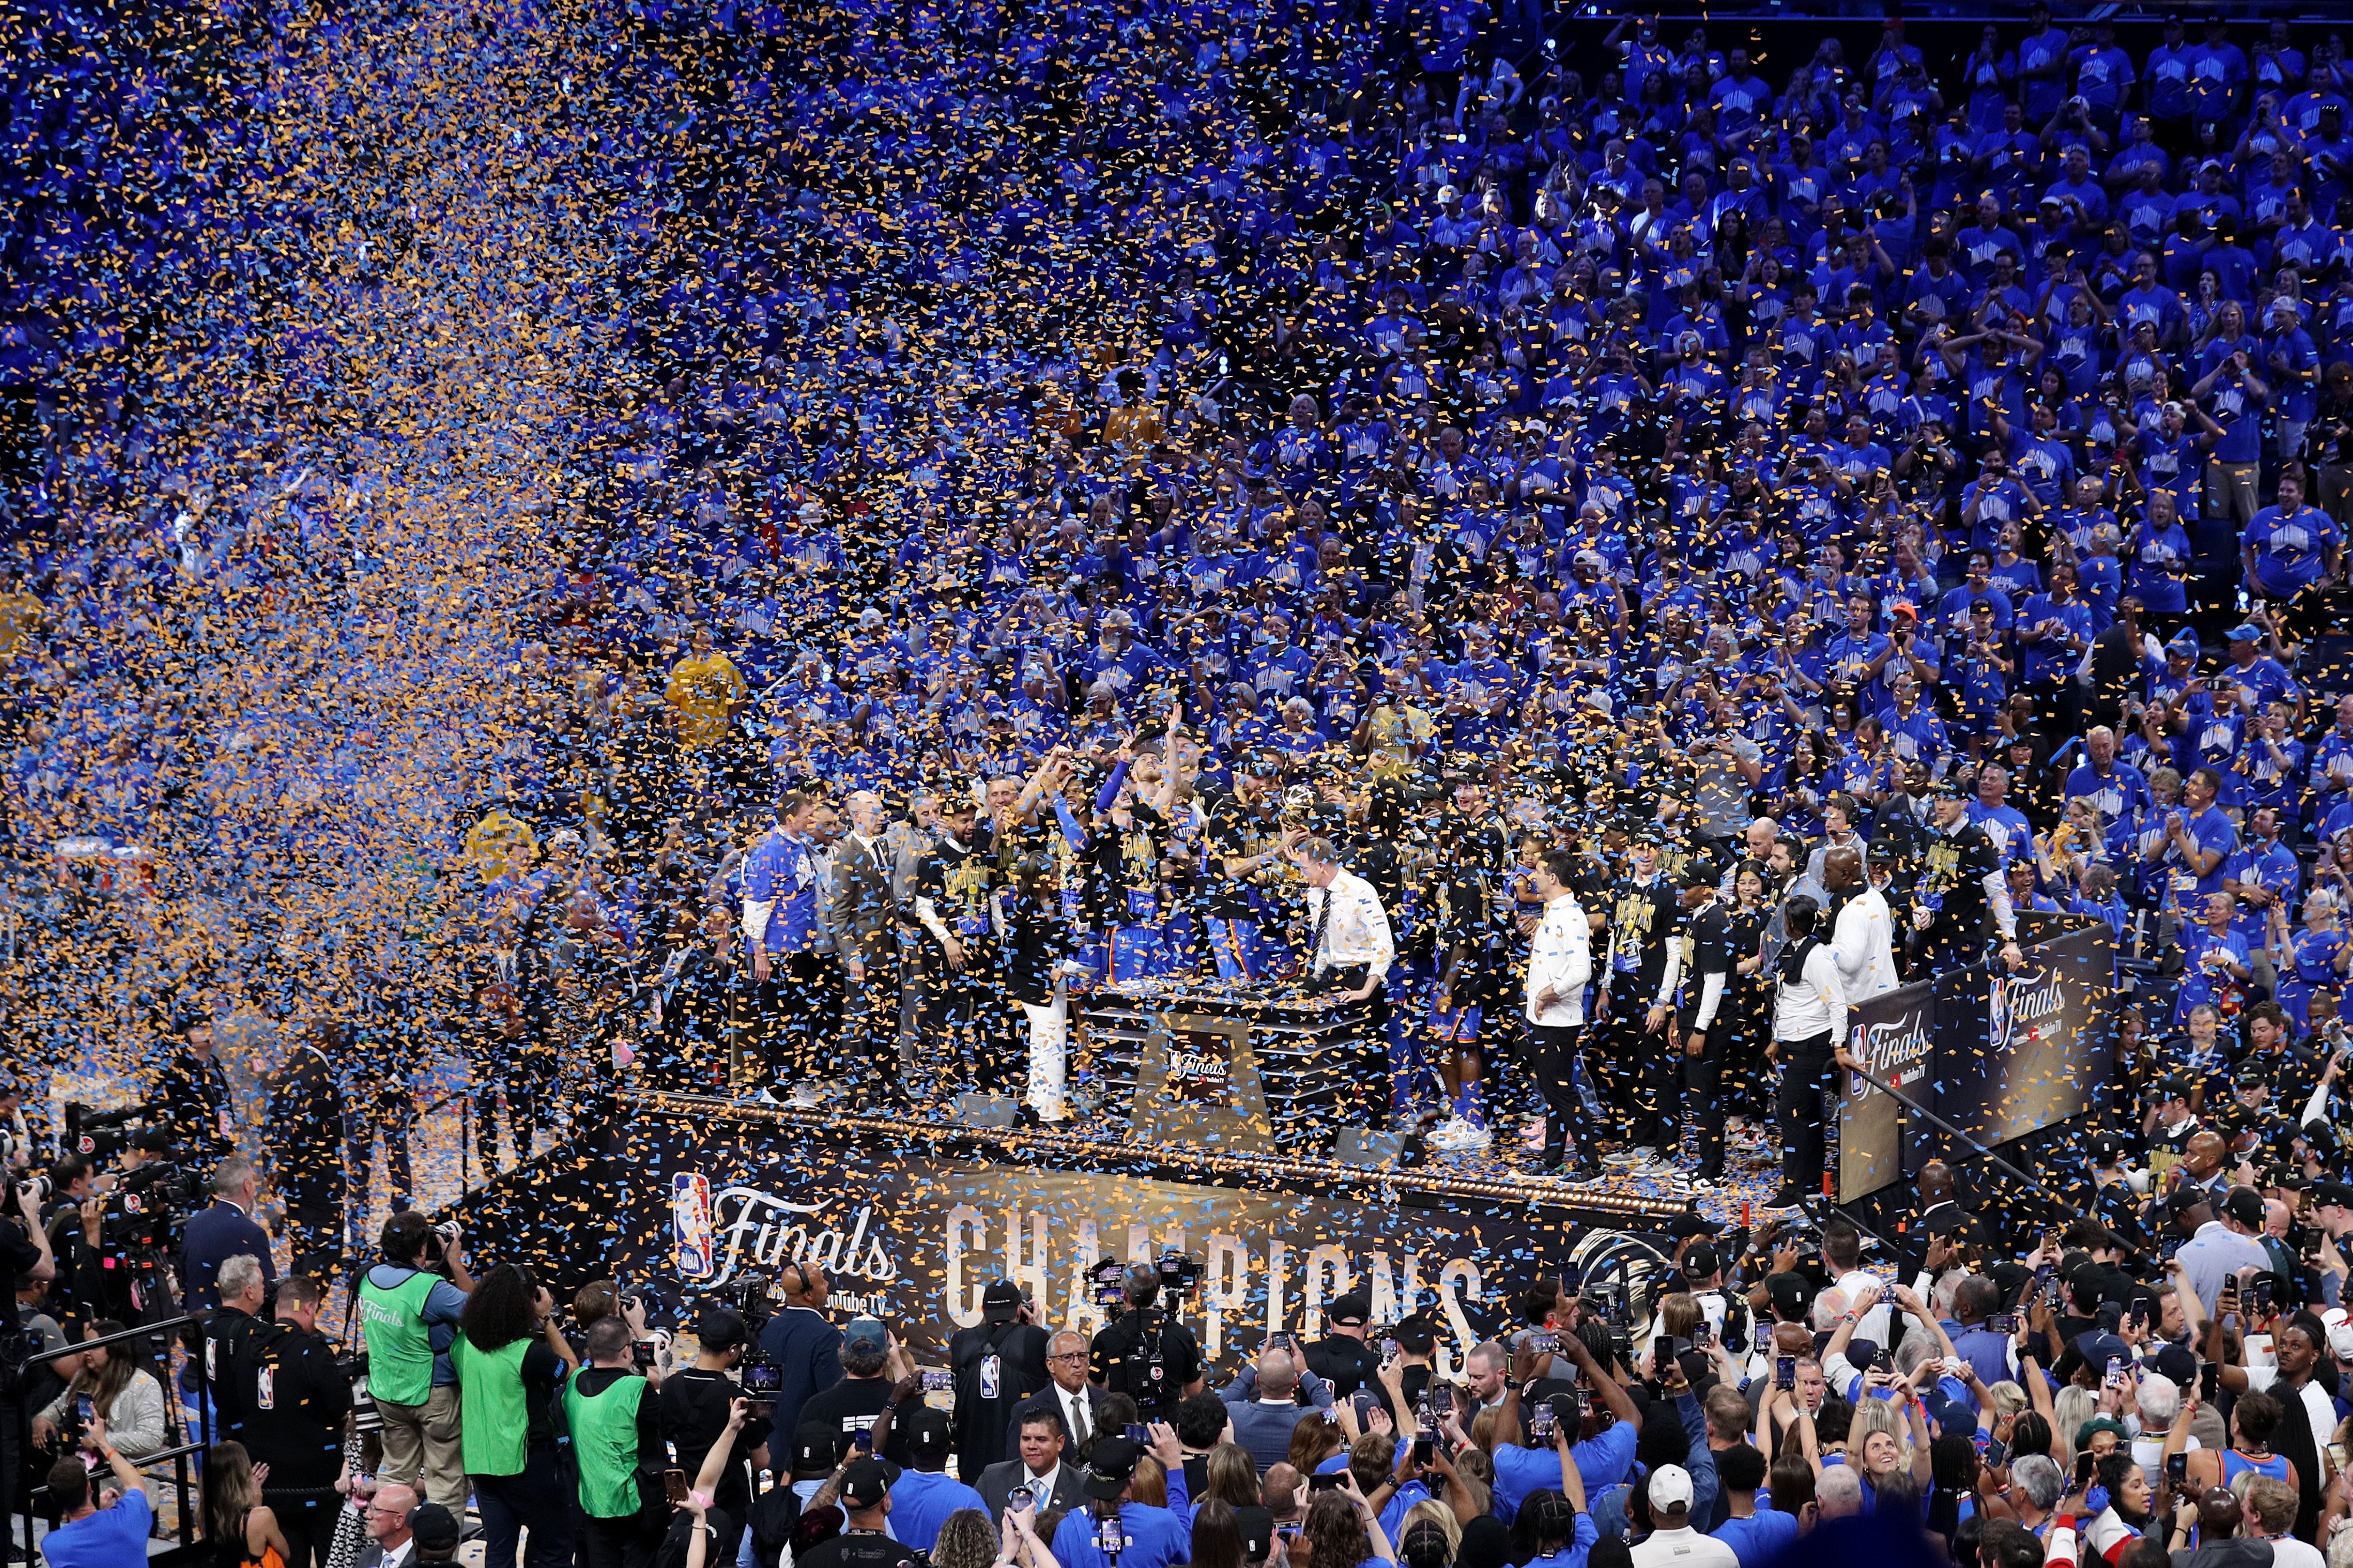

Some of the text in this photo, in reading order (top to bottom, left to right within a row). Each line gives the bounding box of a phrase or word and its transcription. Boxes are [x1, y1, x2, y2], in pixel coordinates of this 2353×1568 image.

[1130, 862, 1140, 874] 20
[1996, 966, 2065, 1052] Finals
[1858, 1010, 1929, 1101] Finals
[1919, 1063, 1926, 1078] TV
[696, 1186, 897, 1289] Finals
[680, 1251, 700, 1271] NBA
[362, 1300, 405, 1327] Finals
[824, 1289, 868, 1313] ouTube
[868, 1293, 887, 1316] TV
